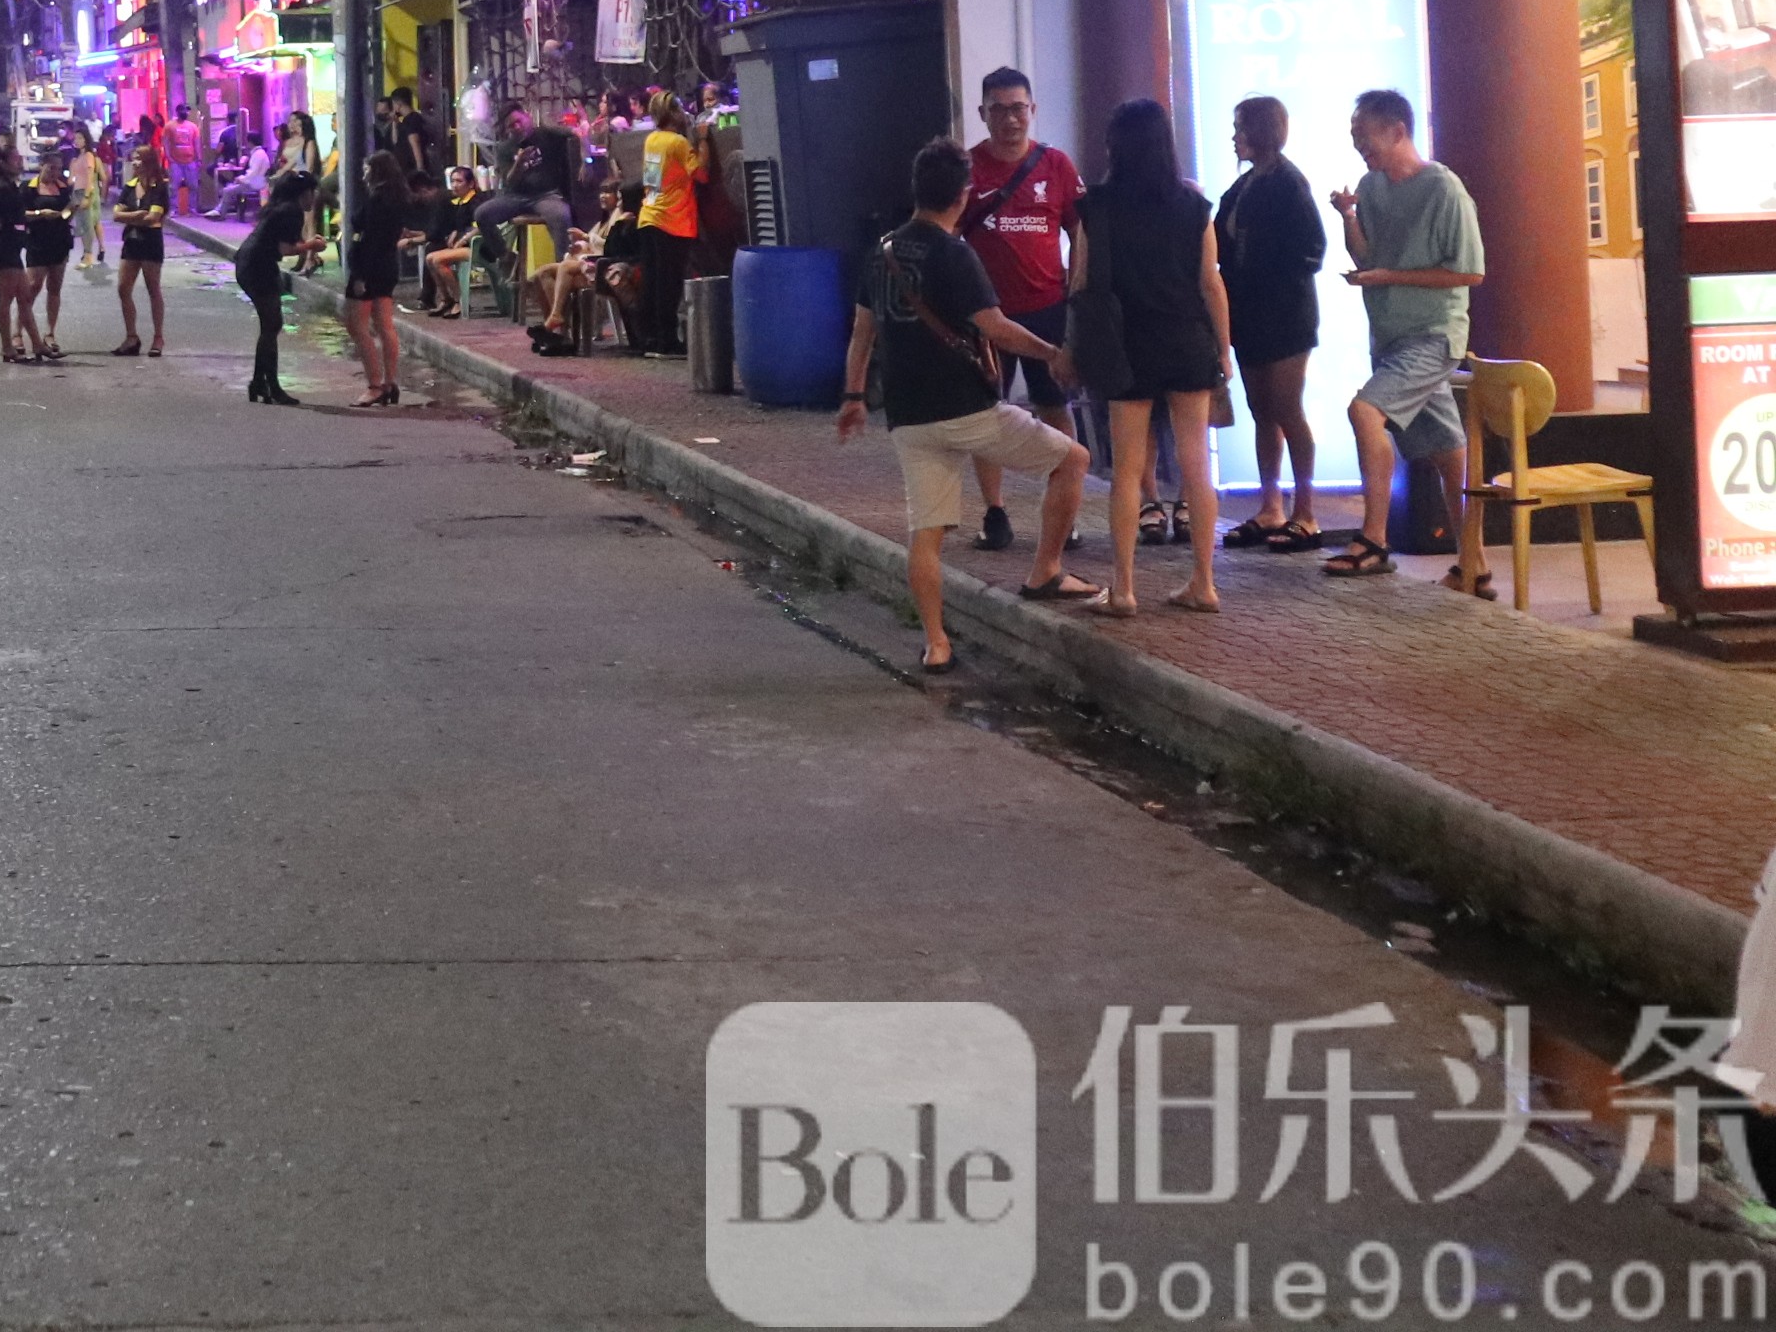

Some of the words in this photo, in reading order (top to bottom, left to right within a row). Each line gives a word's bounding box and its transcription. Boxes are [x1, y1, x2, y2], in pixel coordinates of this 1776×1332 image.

[999, 214, 1047, 225] standard
[999, 223, 1049, 234] chartered
[1700, 344, 1764, 364] ROOM
[1742, 366, 1771, 384] AT
[1706, 539, 1765, 557] Phone
